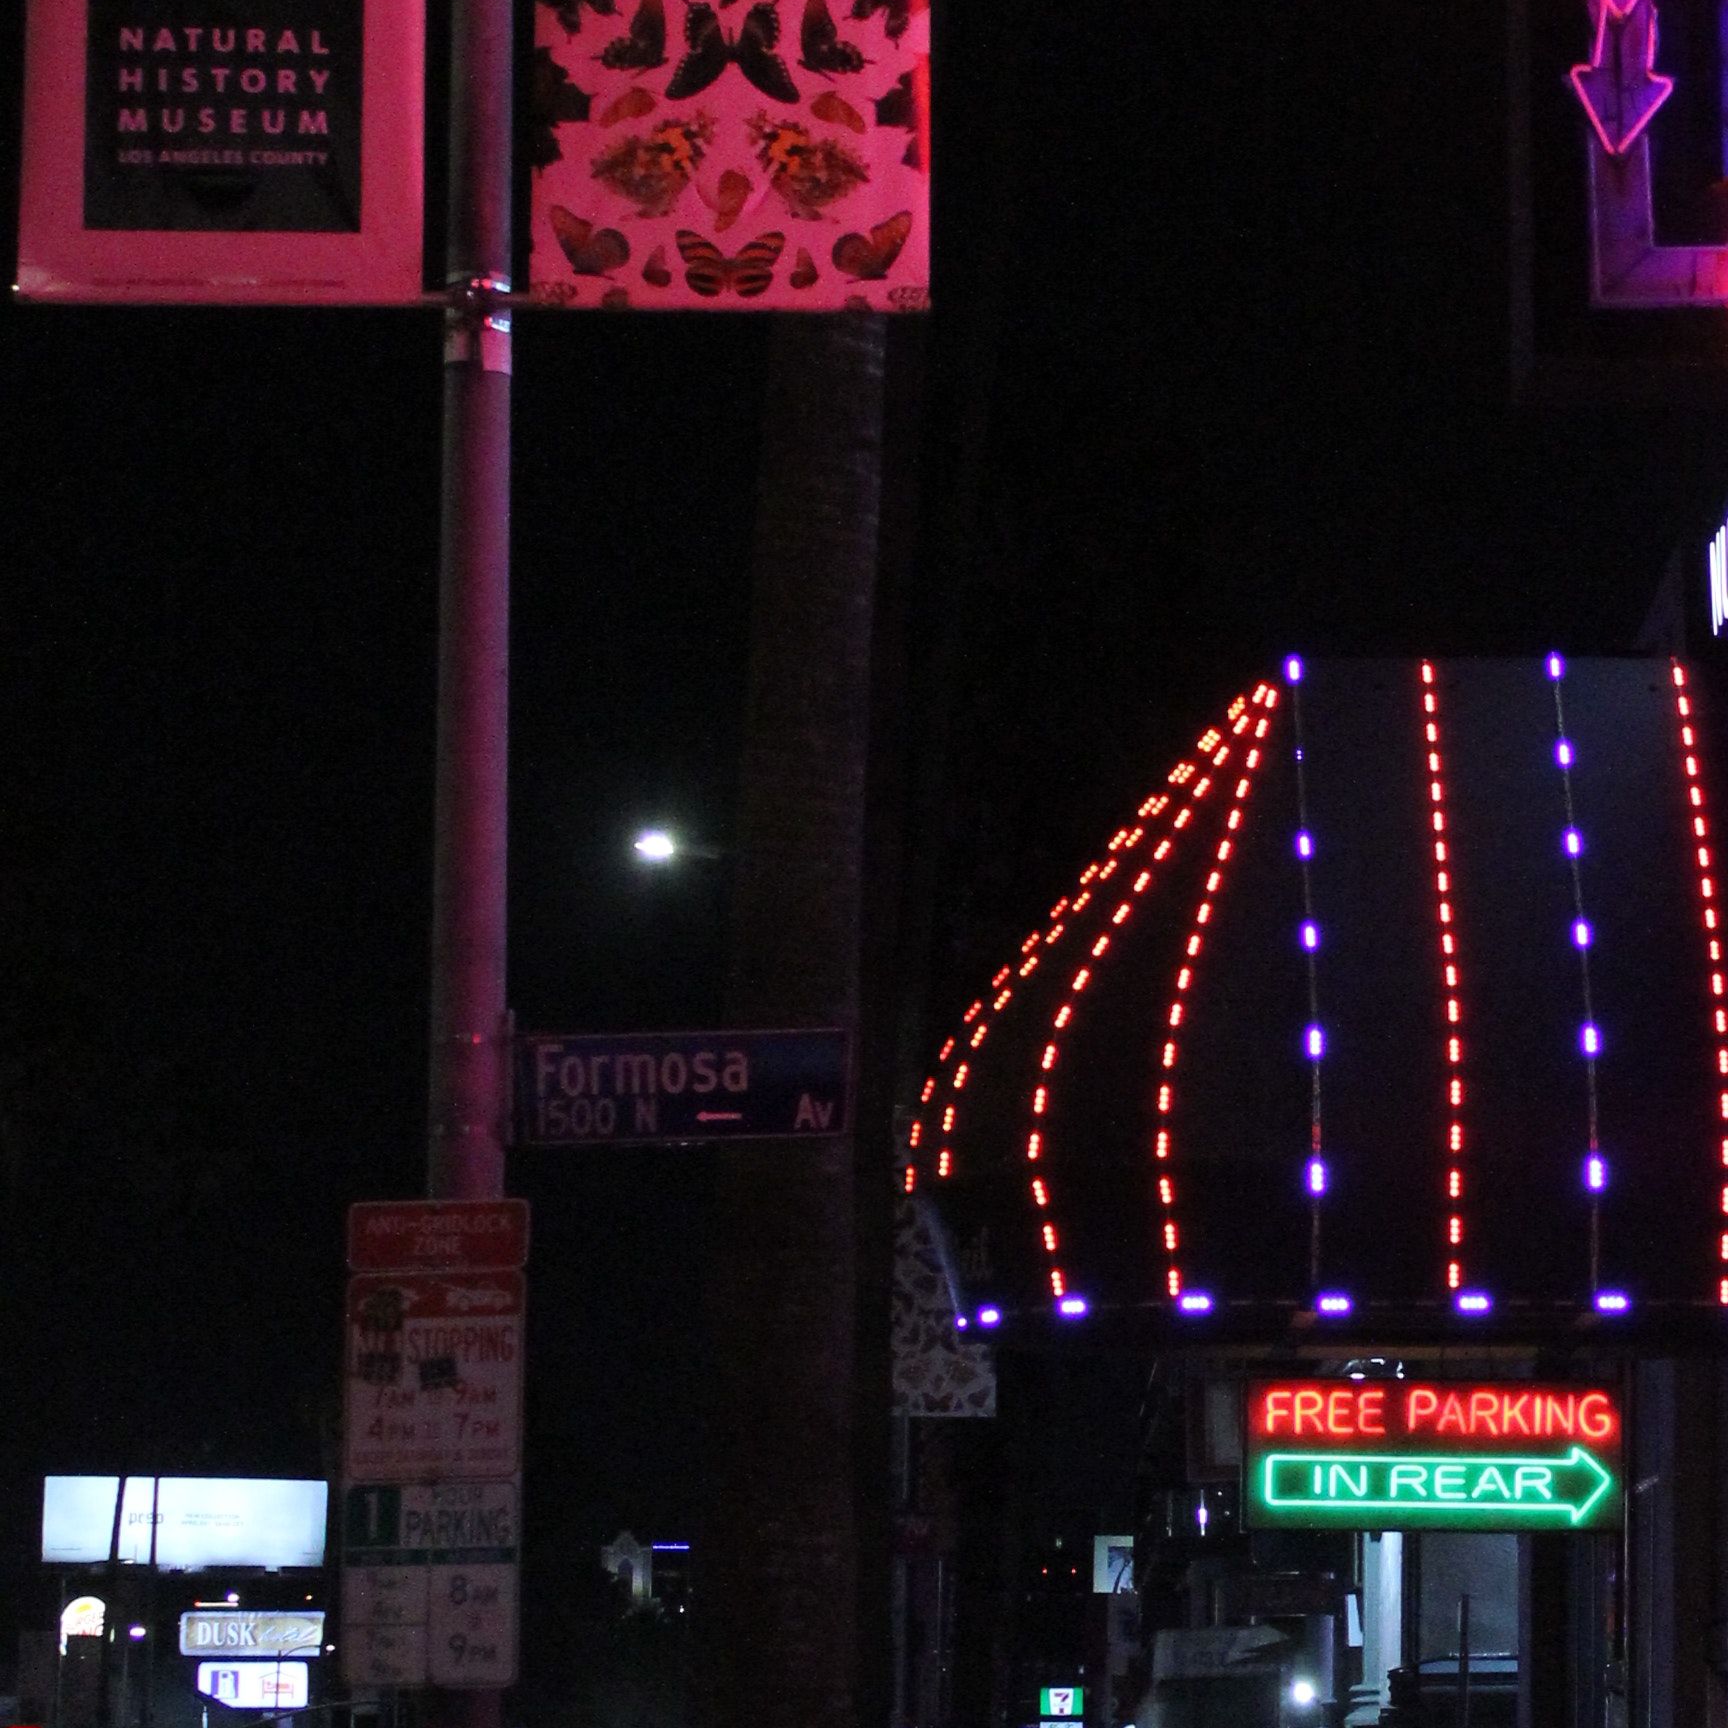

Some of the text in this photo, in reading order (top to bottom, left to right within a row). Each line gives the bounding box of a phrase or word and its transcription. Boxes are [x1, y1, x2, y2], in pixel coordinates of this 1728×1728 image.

[118, 26, 330, 55] NATURAL
[118, 67, 330, 94] HISTORY
[117, 107, 329, 135] MUSEUM
[118, 149, 329, 166] LOS ANGELES COUNTY
[536, 1042, 749, 1097] Formosa
[537, 1091, 835, 1136] 1500 N Av
[414, 1235, 462, 1257] ZONE
[408, 1325, 515, 1363] STOPPING
[1264, 1388, 1613, 1438] FREE PARKING
[1312, 1463, 1553, 1500] IN REAR
[365, 1492, 378, 1540] 1
[405, 1506, 512, 1545] PARKING
[197, 1621, 256, 1646] DUSK
